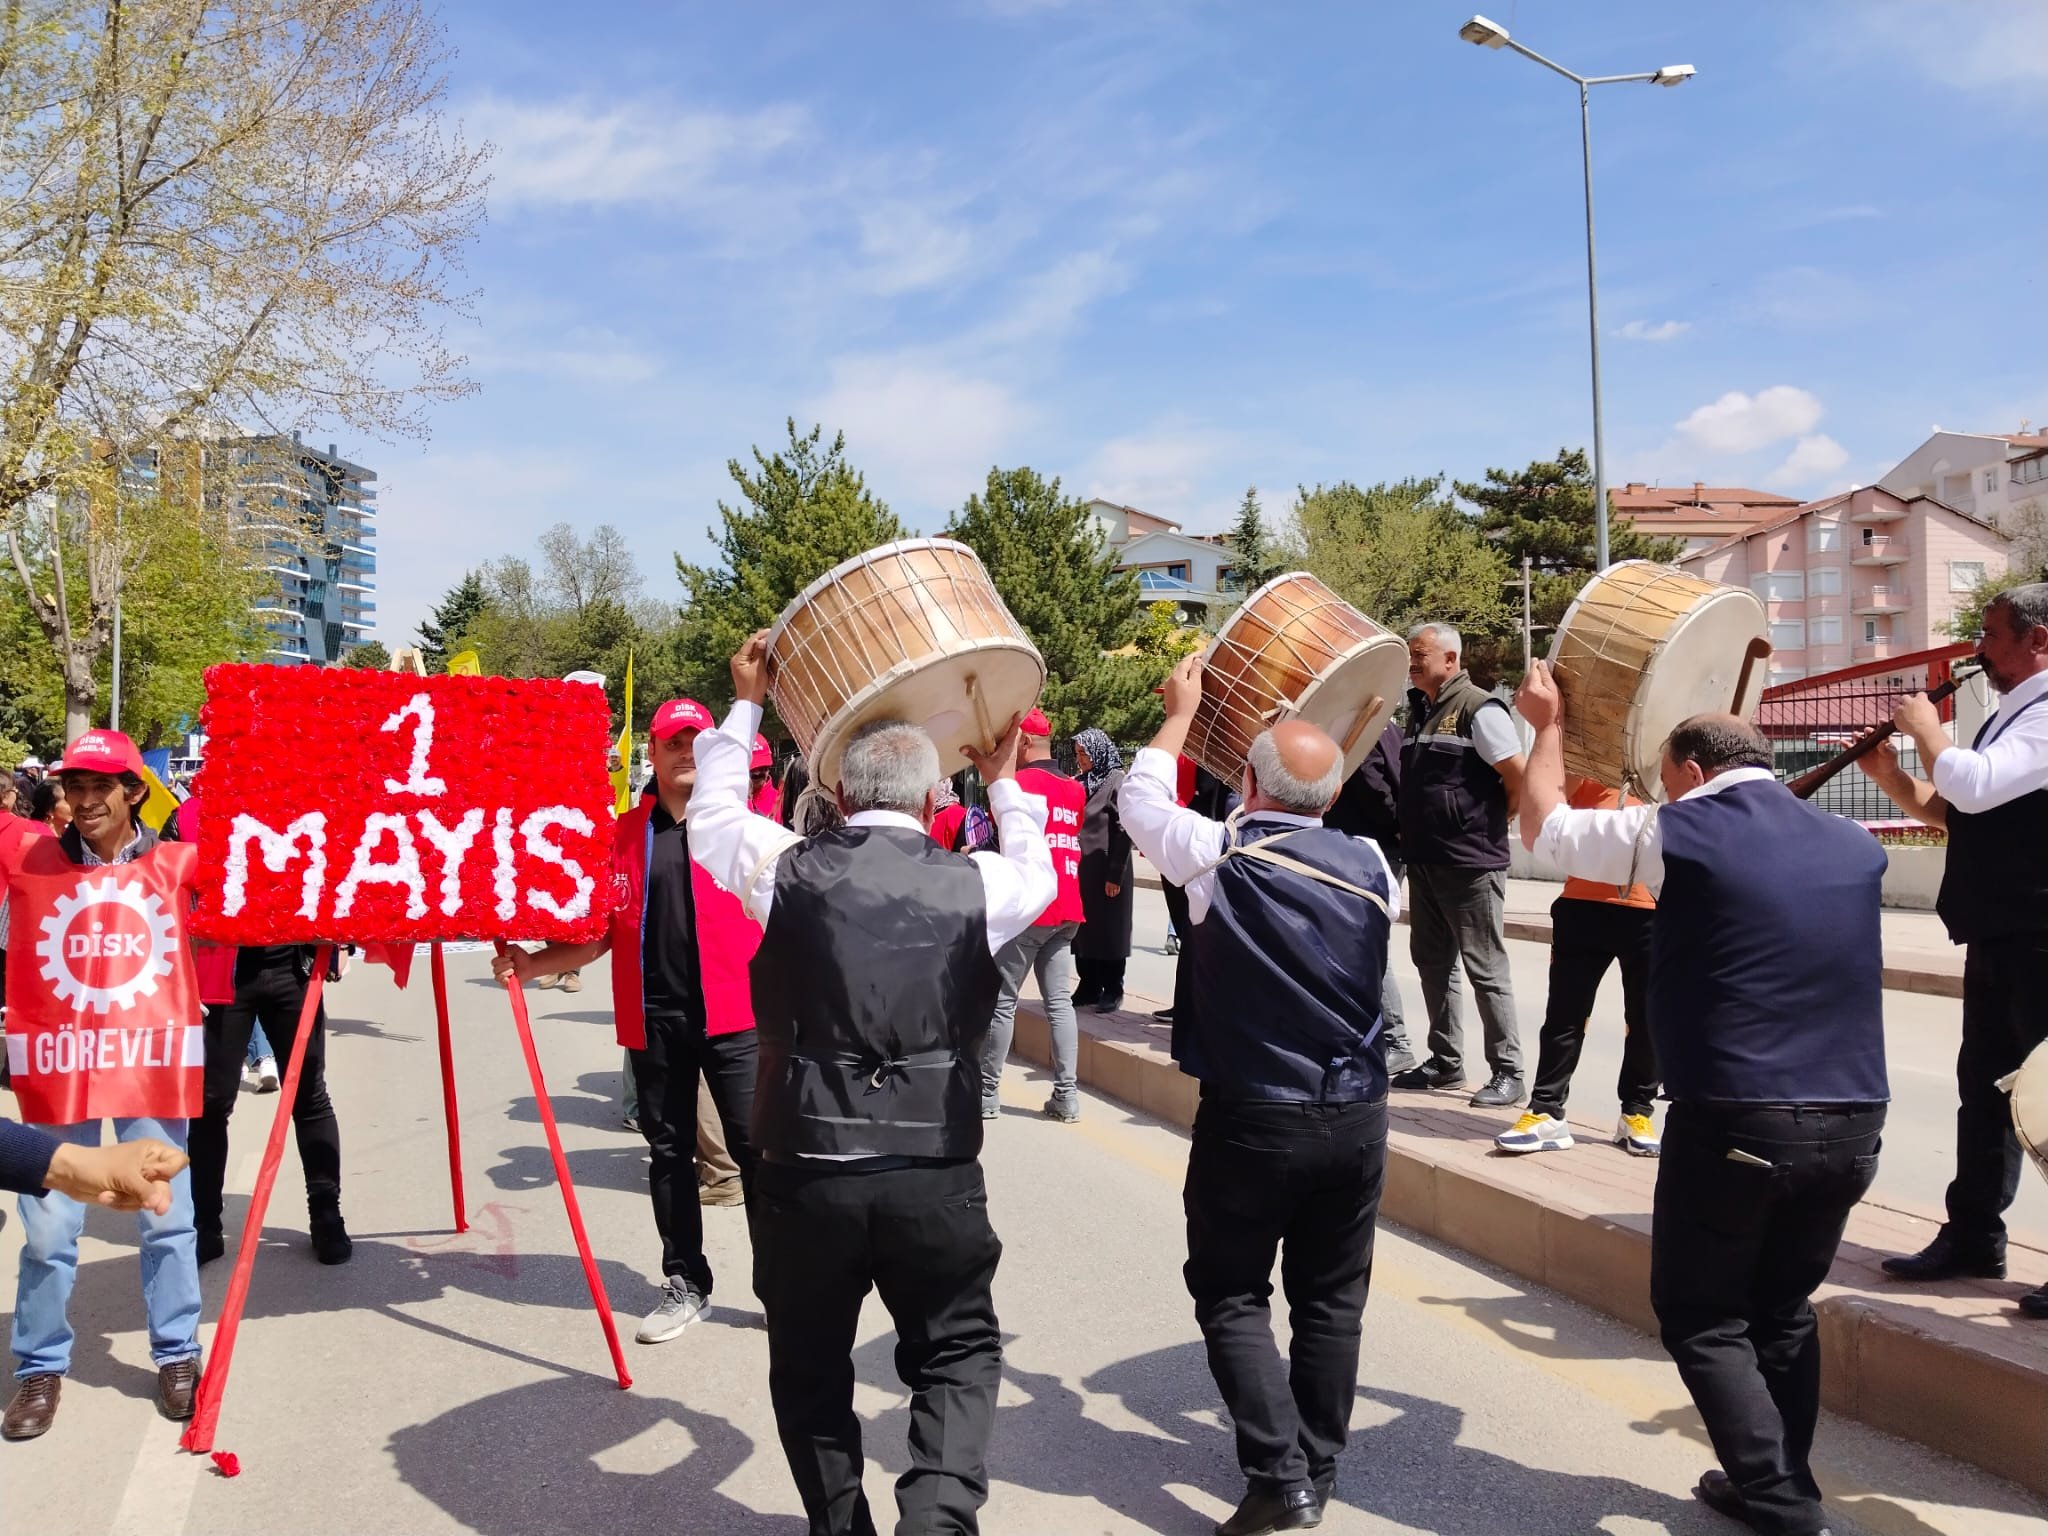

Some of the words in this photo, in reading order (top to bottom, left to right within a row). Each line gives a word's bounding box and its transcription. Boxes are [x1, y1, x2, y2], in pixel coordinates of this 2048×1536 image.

[380, 692, 448, 797] 1
[221, 804, 597, 922] MAYIS
[68, 921, 146, 959] DİSK
[35, 1019, 175, 1076] GÖREVLİ
